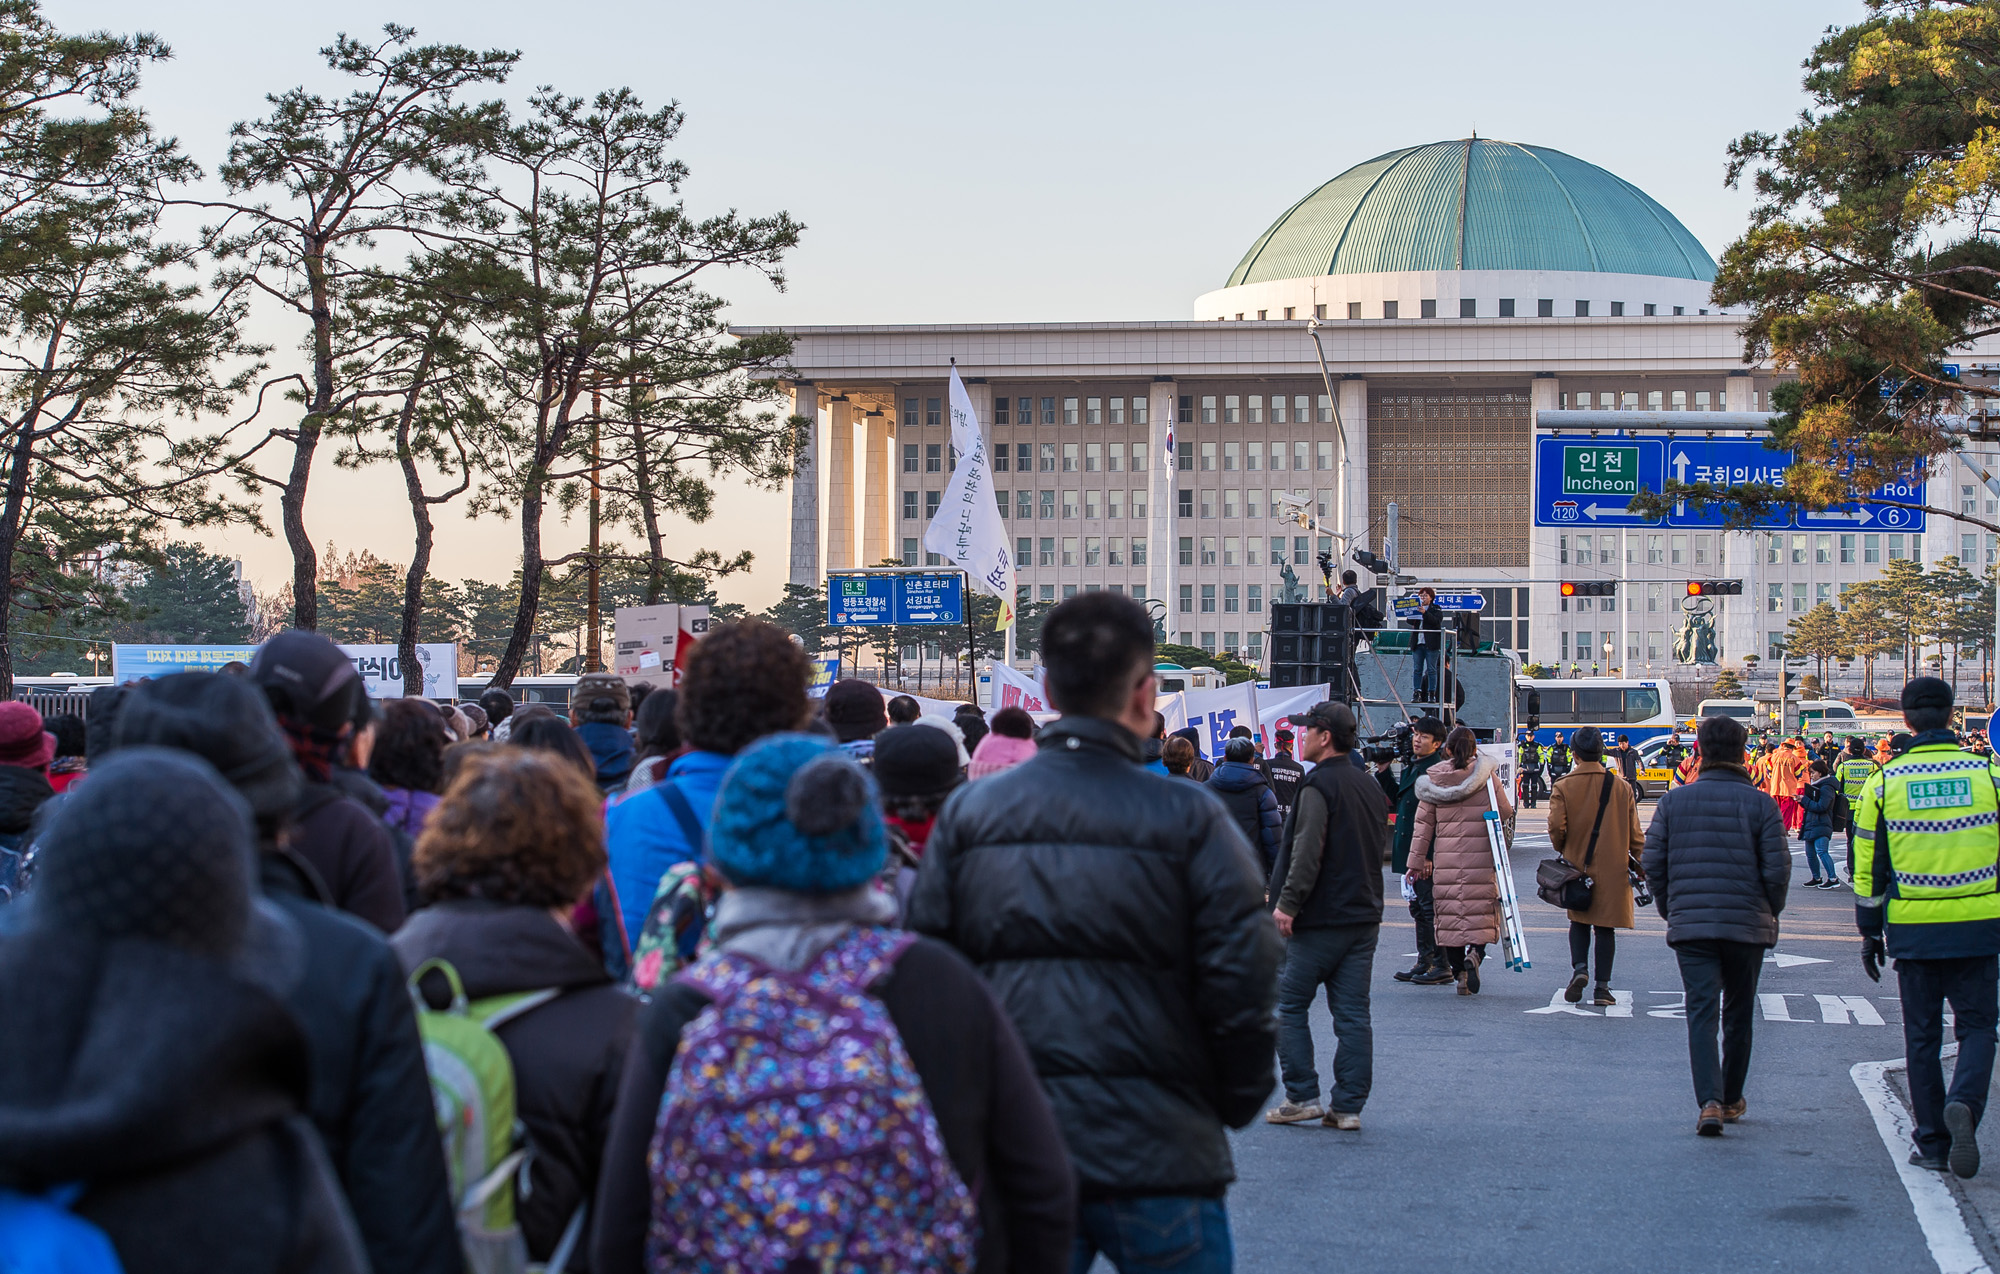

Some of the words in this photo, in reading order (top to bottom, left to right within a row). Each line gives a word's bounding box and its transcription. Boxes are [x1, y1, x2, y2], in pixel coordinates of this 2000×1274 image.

[1579, 451, 1622, 473] 인천
[1694, 465, 1786, 488] 국회의사당
[1566, 475, 1635, 491] Incheon
[1883, 482, 1914, 497] Rot
[1556, 507, 1575, 519] 120
[1888, 509, 1900, 525] 6
[844, 582, 864, 591] 인천
[905, 580, 949, 590] 신촌로터리
[842, 596, 886, 607] 영등포경찰서
[905, 595, 941, 605] 서강대교
[944, 612, 950, 620] 6
[1914, 796, 1965, 807] POLICE
